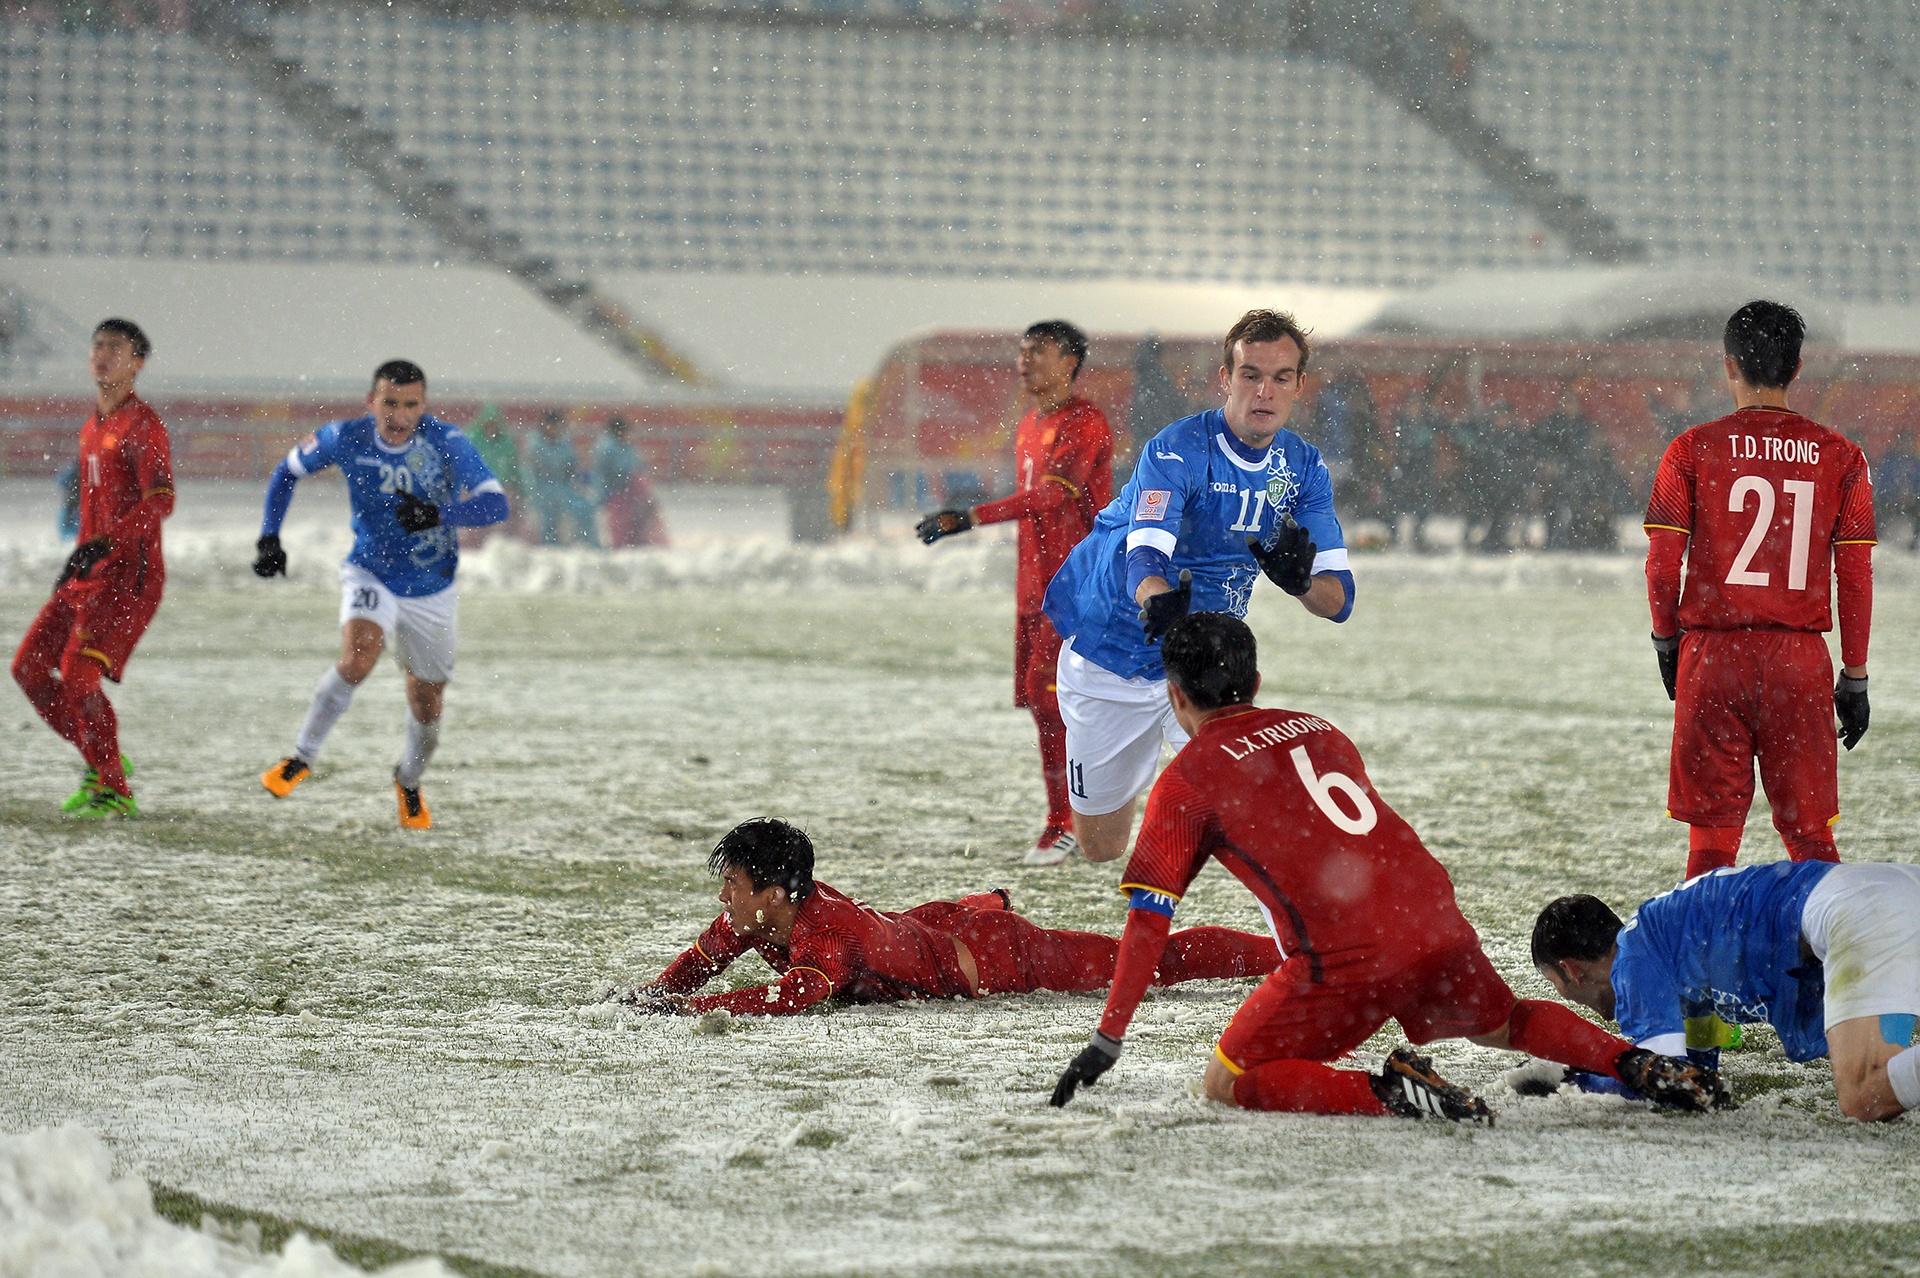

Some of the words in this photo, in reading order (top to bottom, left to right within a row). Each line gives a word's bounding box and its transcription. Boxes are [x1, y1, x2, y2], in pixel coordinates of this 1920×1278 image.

[1728, 434, 1820, 465] T.D.TRONG
[380, 463, 413, 494] 20
[1269, 483, 1283, 493] UFF
[1230, 488, 1267, 532] 11
[1724, 475, 1815, 591] 21
[352, 588, 379, 611] 20
[1220, 716, 1332, 761] L.X.TRUONG
[1069, 758, 1088, 799] 11
[1289, 744, 1378, 836] 6
